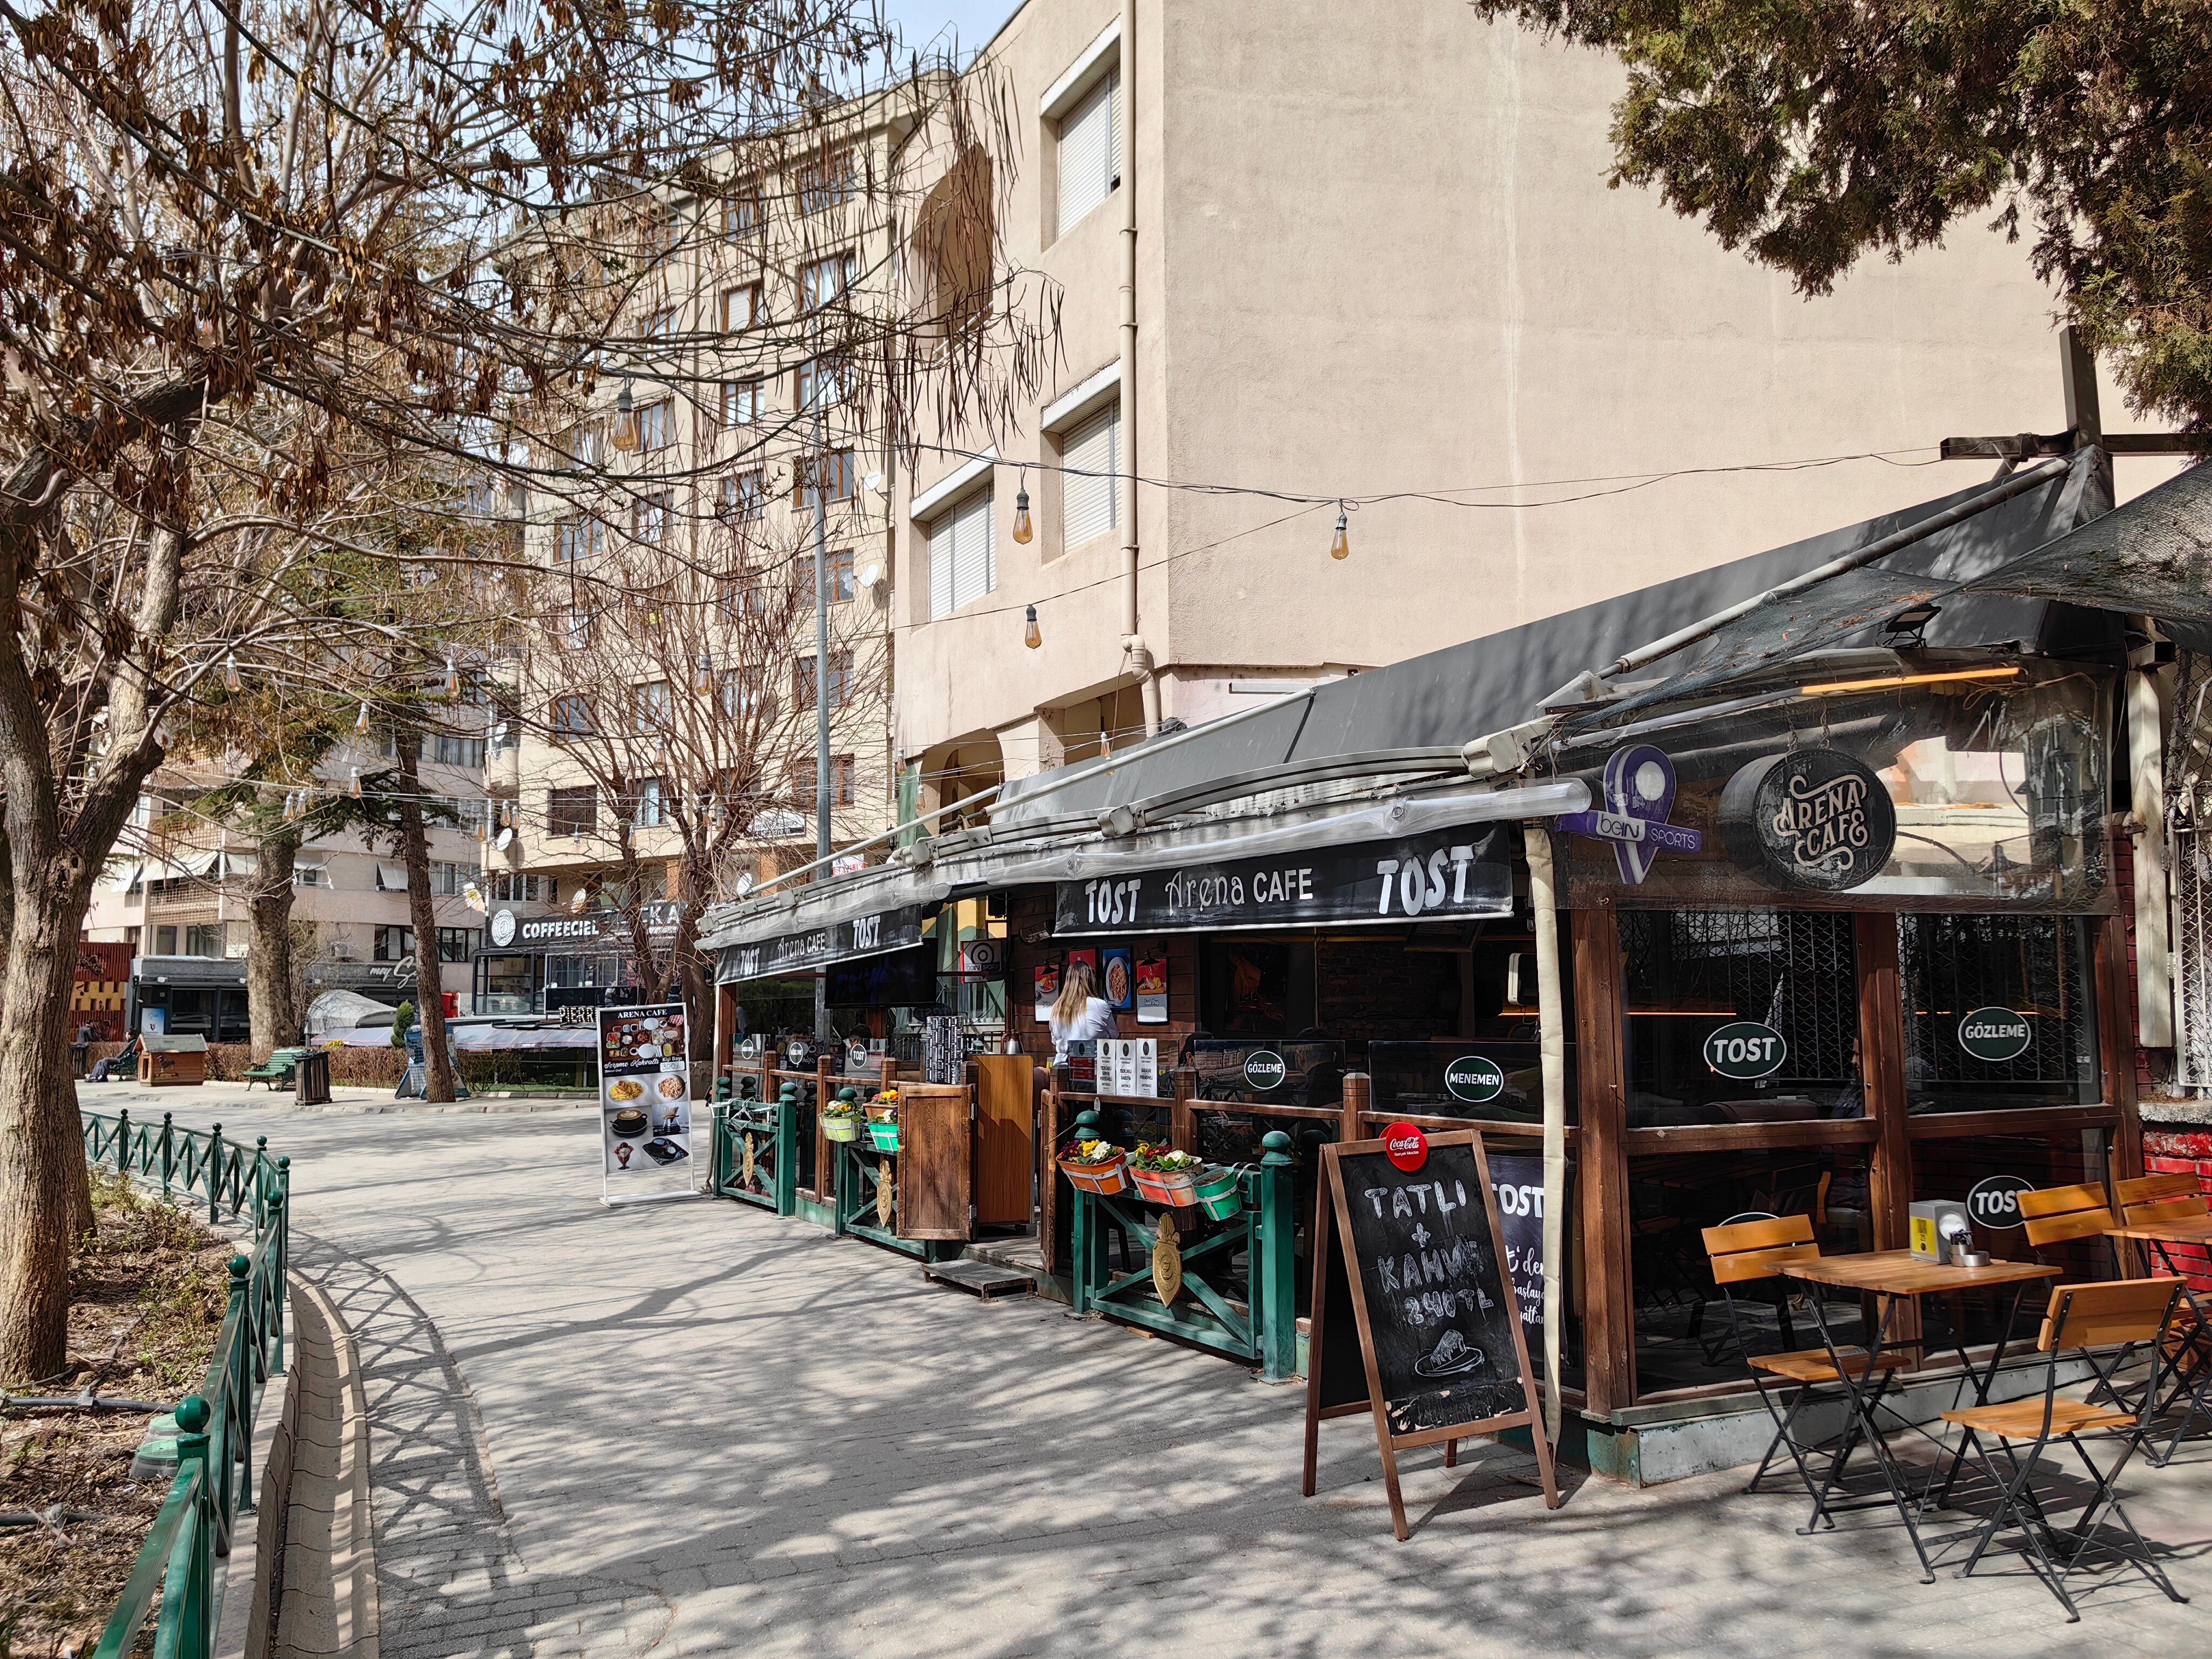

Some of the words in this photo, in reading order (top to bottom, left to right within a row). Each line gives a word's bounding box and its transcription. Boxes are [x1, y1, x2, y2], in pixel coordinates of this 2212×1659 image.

[1773, 778, 1865, 835] ARENA
[1651, 828, 1695, 849] SPORTS
[1804, 809, 1868, 857] CAFE
[1085, 879, 1141, 925] TOST
[1165, 871, 1245, 916] Arena
[1253, 868, 1313, 903] CAFE
[1376, 845, 1473, 916] TOST
[740, 947, 760, 975] TOST
[778, 937, 805, 964] Arena
[807, 933, 825, 953] CAFE
[853, 915, 880, 950] TOST
[370, 967, 392, 982] mey
[559, 1006, 598, 1023] PIERR
[617, 1011, 645, 1019] ARENA
[1965, 1021, 2026, 1038] GÖZLEME
[853, 1050, 865, 1061] TOST
[1714, 1037, 1776, 1063] TOST
[1247, 1061, 1282, 1073] GÖZLEME
[1449, 1073, 1499, 1085] MENEMEN
[1365, 1179, 1466, 1219] TATLI
[1975, 1189, 2029, 1215] TOS
